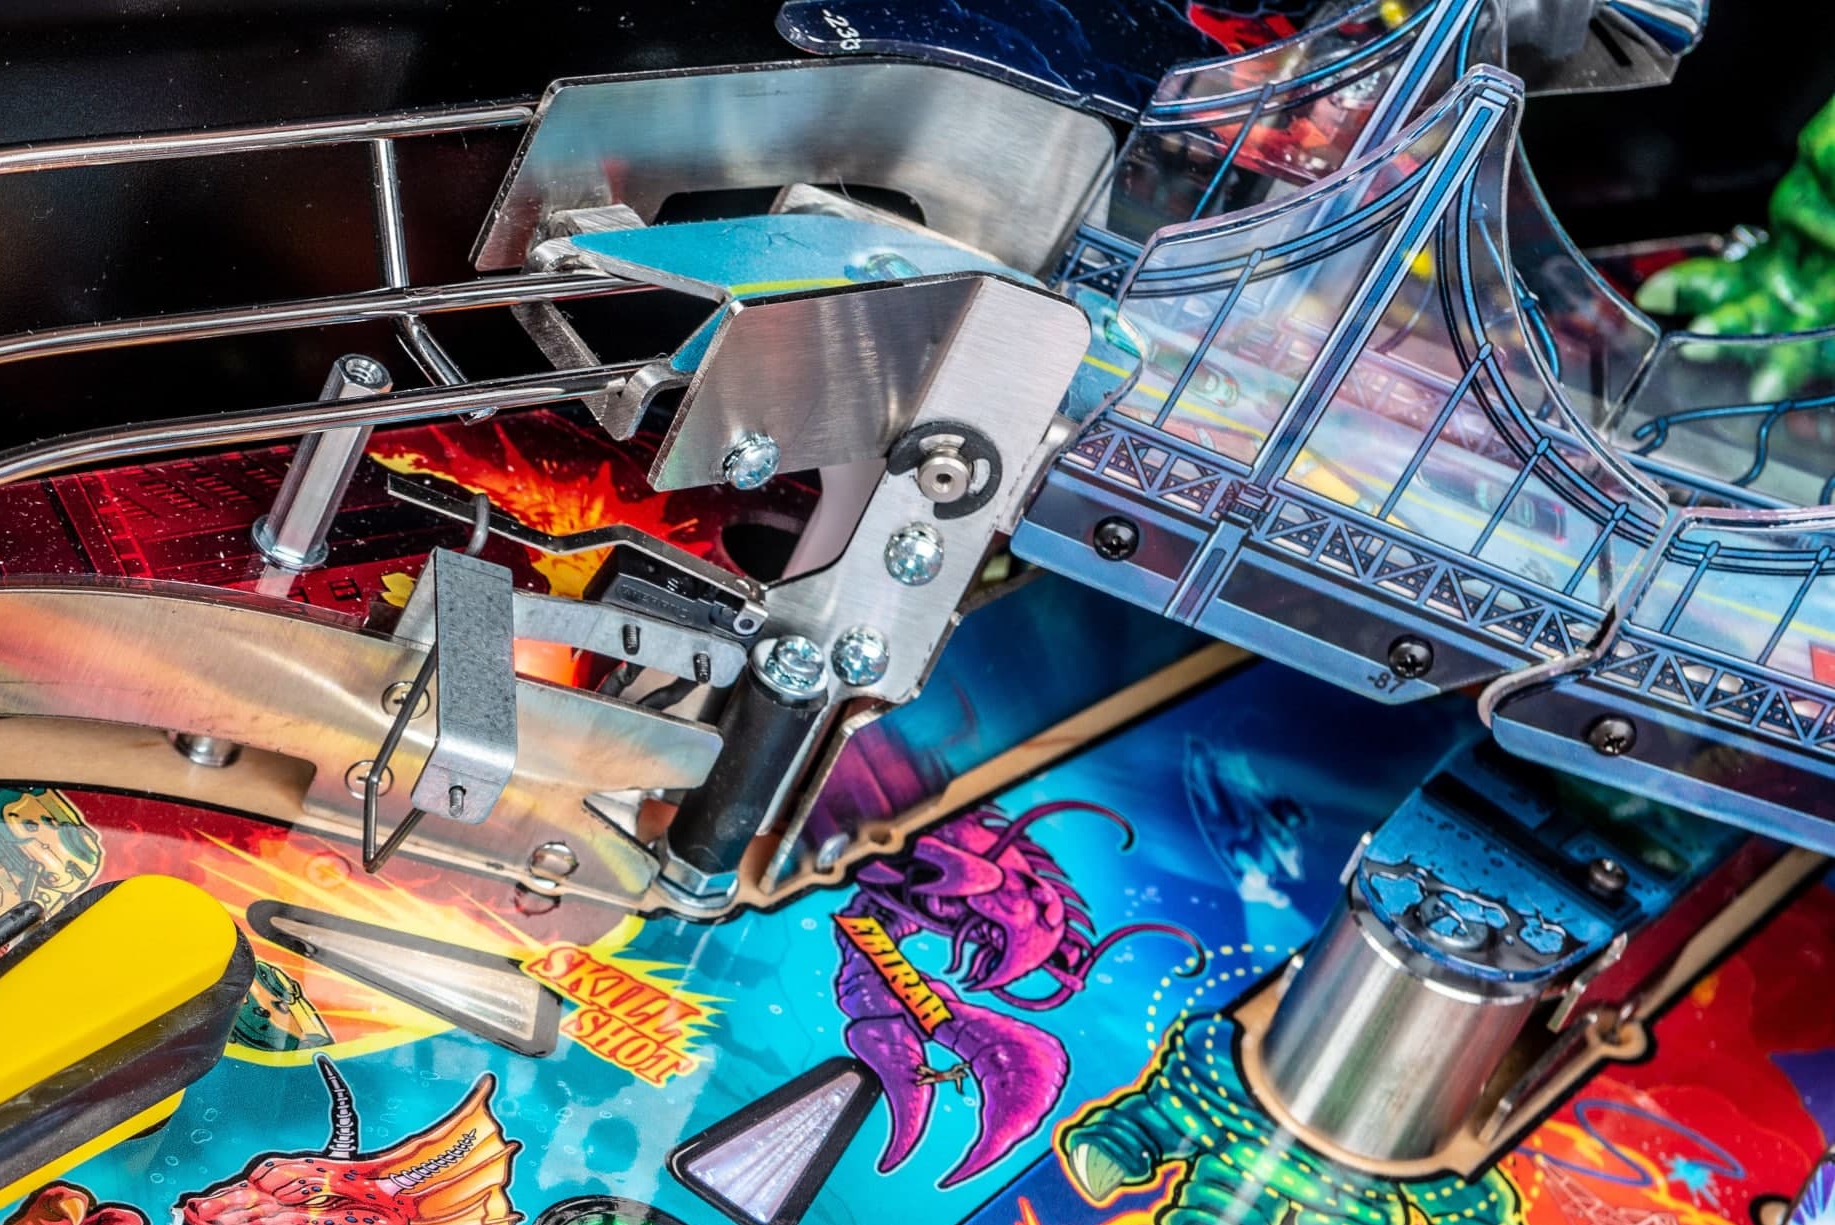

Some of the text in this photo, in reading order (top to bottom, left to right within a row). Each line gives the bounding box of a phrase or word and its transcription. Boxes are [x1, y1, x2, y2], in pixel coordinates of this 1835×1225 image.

[1367, 671, 1407, 695] -87
[525, 945, 704, 1048] SKILL
[832, 914, 955, 1038] EBIRAH
[559, 1006, 697, 1086] SHOT
